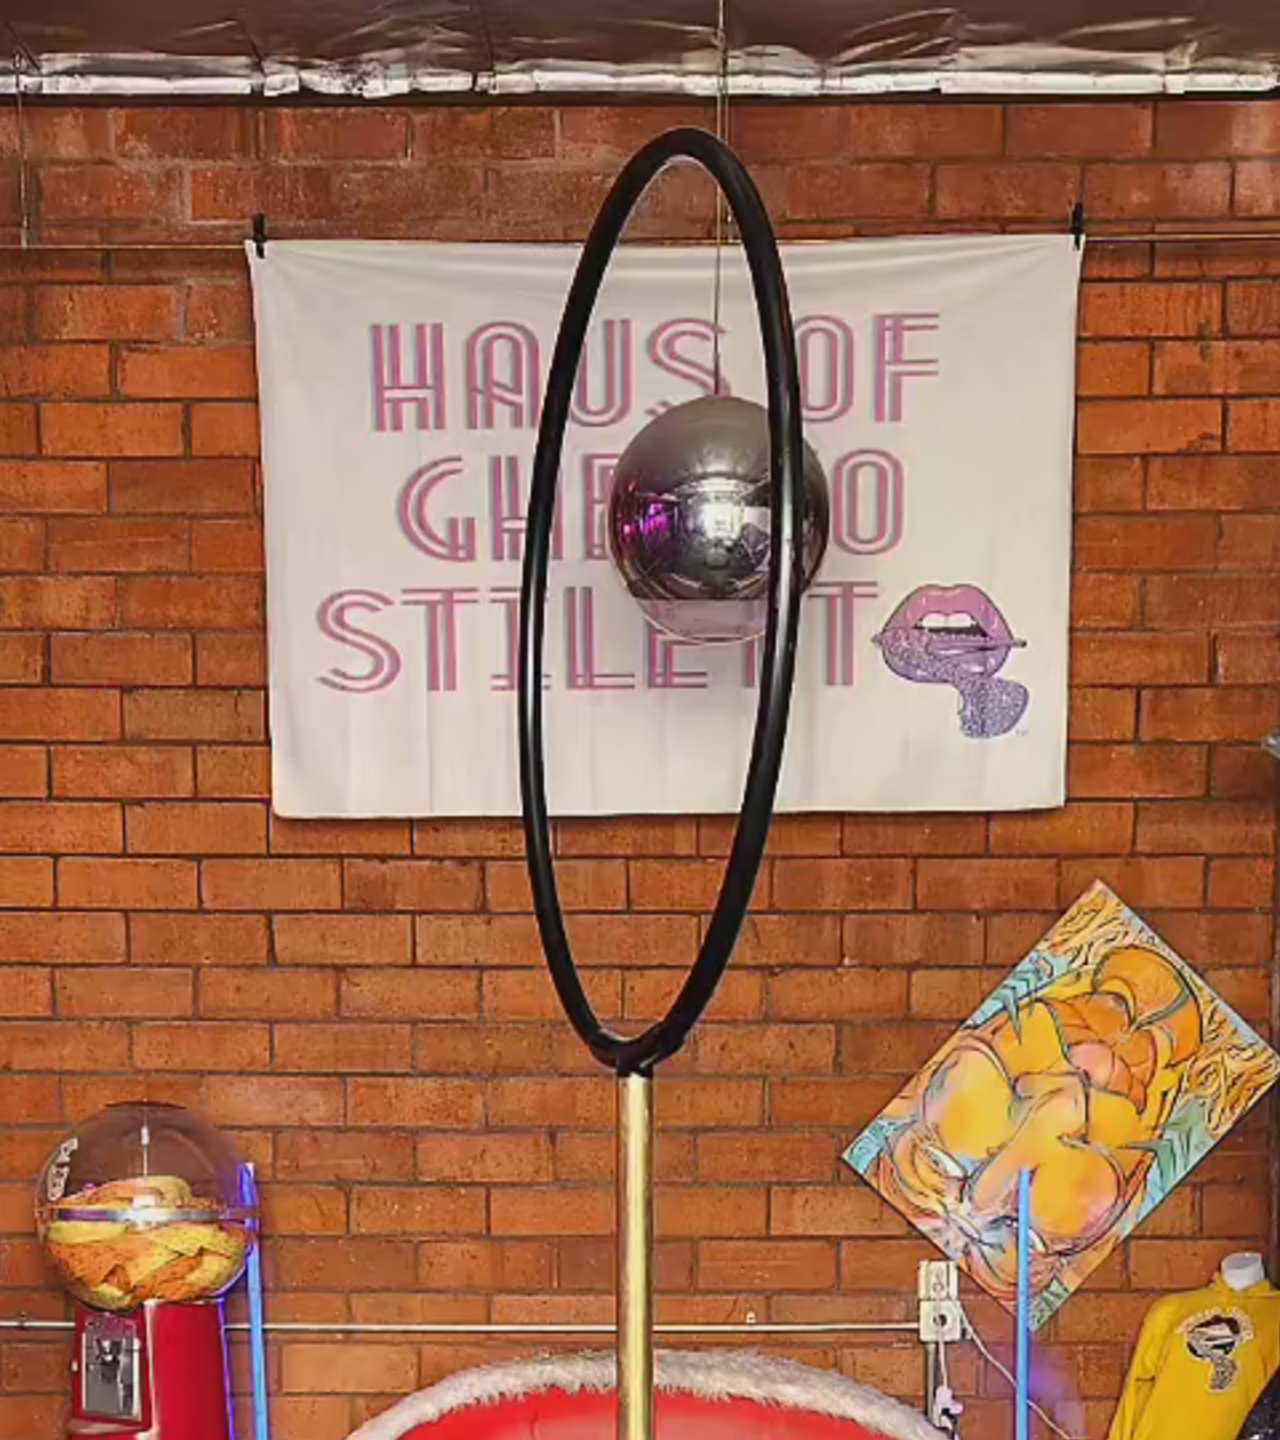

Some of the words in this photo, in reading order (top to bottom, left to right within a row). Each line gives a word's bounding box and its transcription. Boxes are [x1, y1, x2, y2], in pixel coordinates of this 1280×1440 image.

[370, 317, 732, 432] HAUS
[797, 311, 941, 424] OF
[397, 448, 905, 564] GHEO
